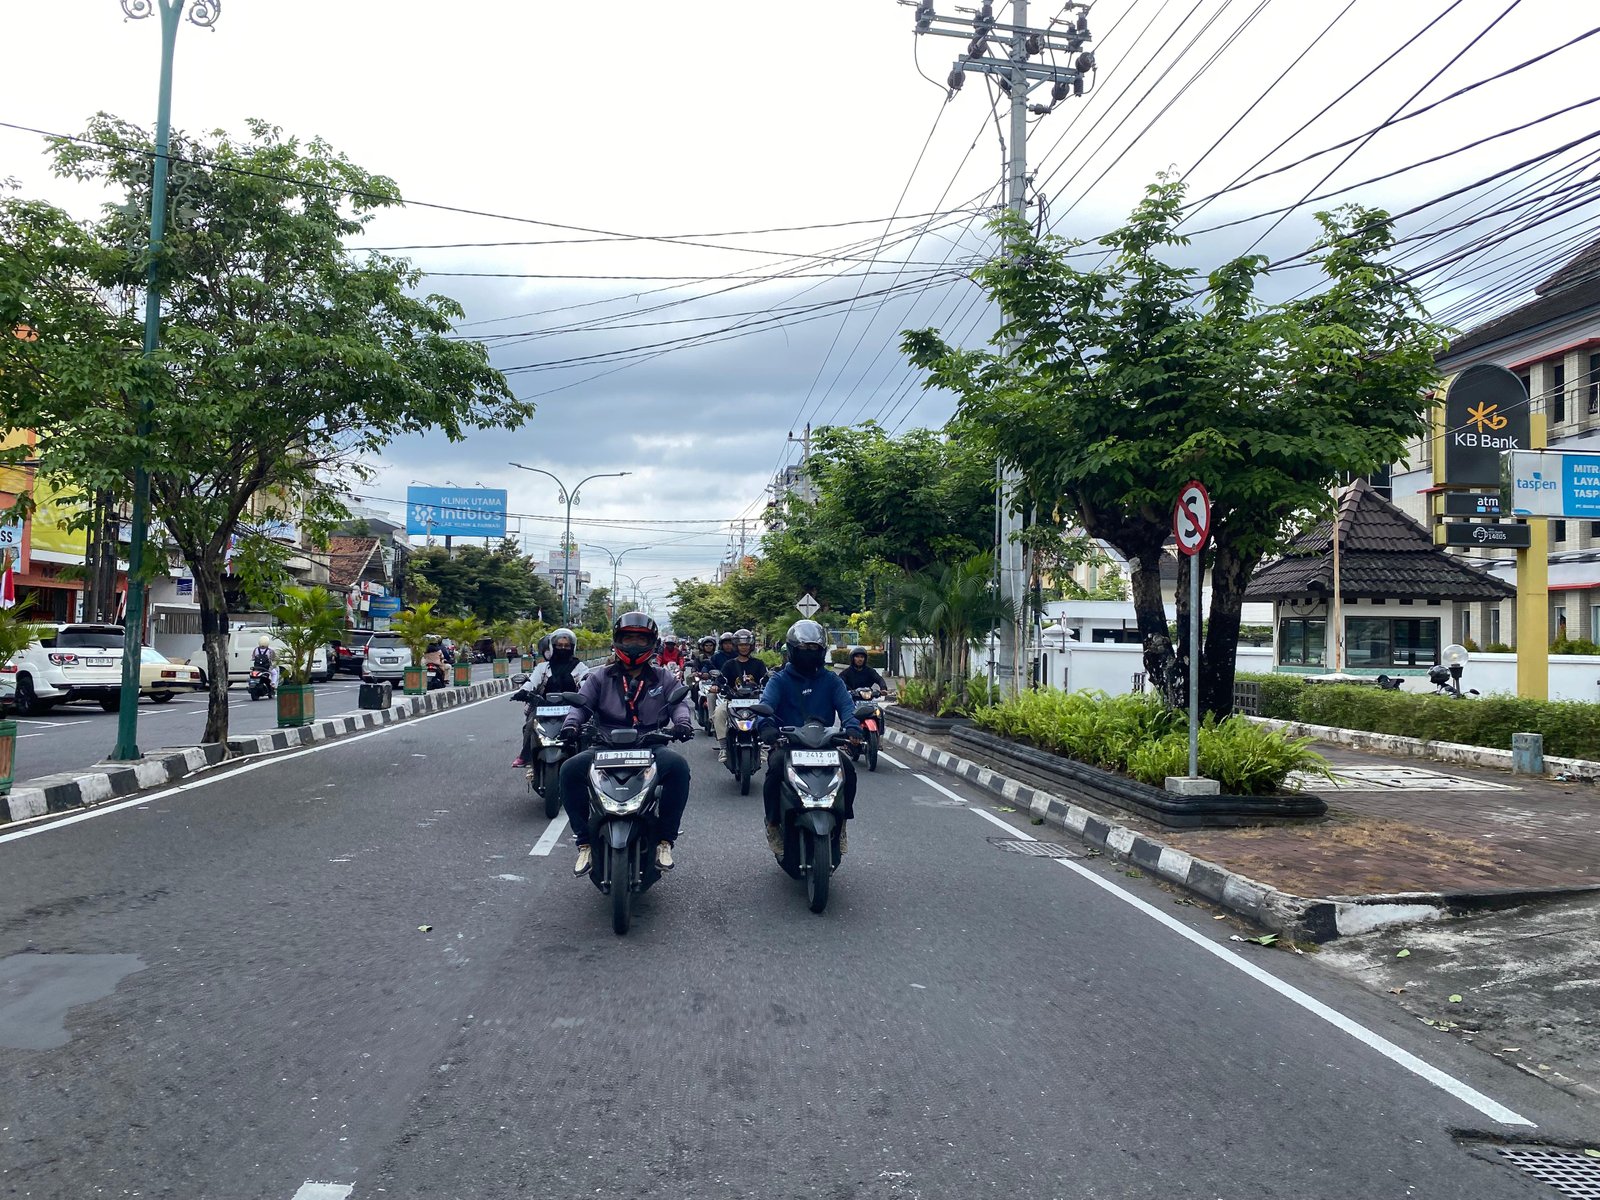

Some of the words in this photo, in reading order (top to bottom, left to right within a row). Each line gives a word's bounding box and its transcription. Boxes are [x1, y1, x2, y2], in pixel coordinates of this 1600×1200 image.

[1455, 432, 1478, 447] KB
[1481, 434, 1519, 449] Bank
[1573, 464, 1600, 474] MITR
[1516, 478, 1557, 492] taspen
[441, 497, 469, 505] KLINIK
[471, 498, 502, 506] UTAMA
[1477, 496, 1499, 506] atm
